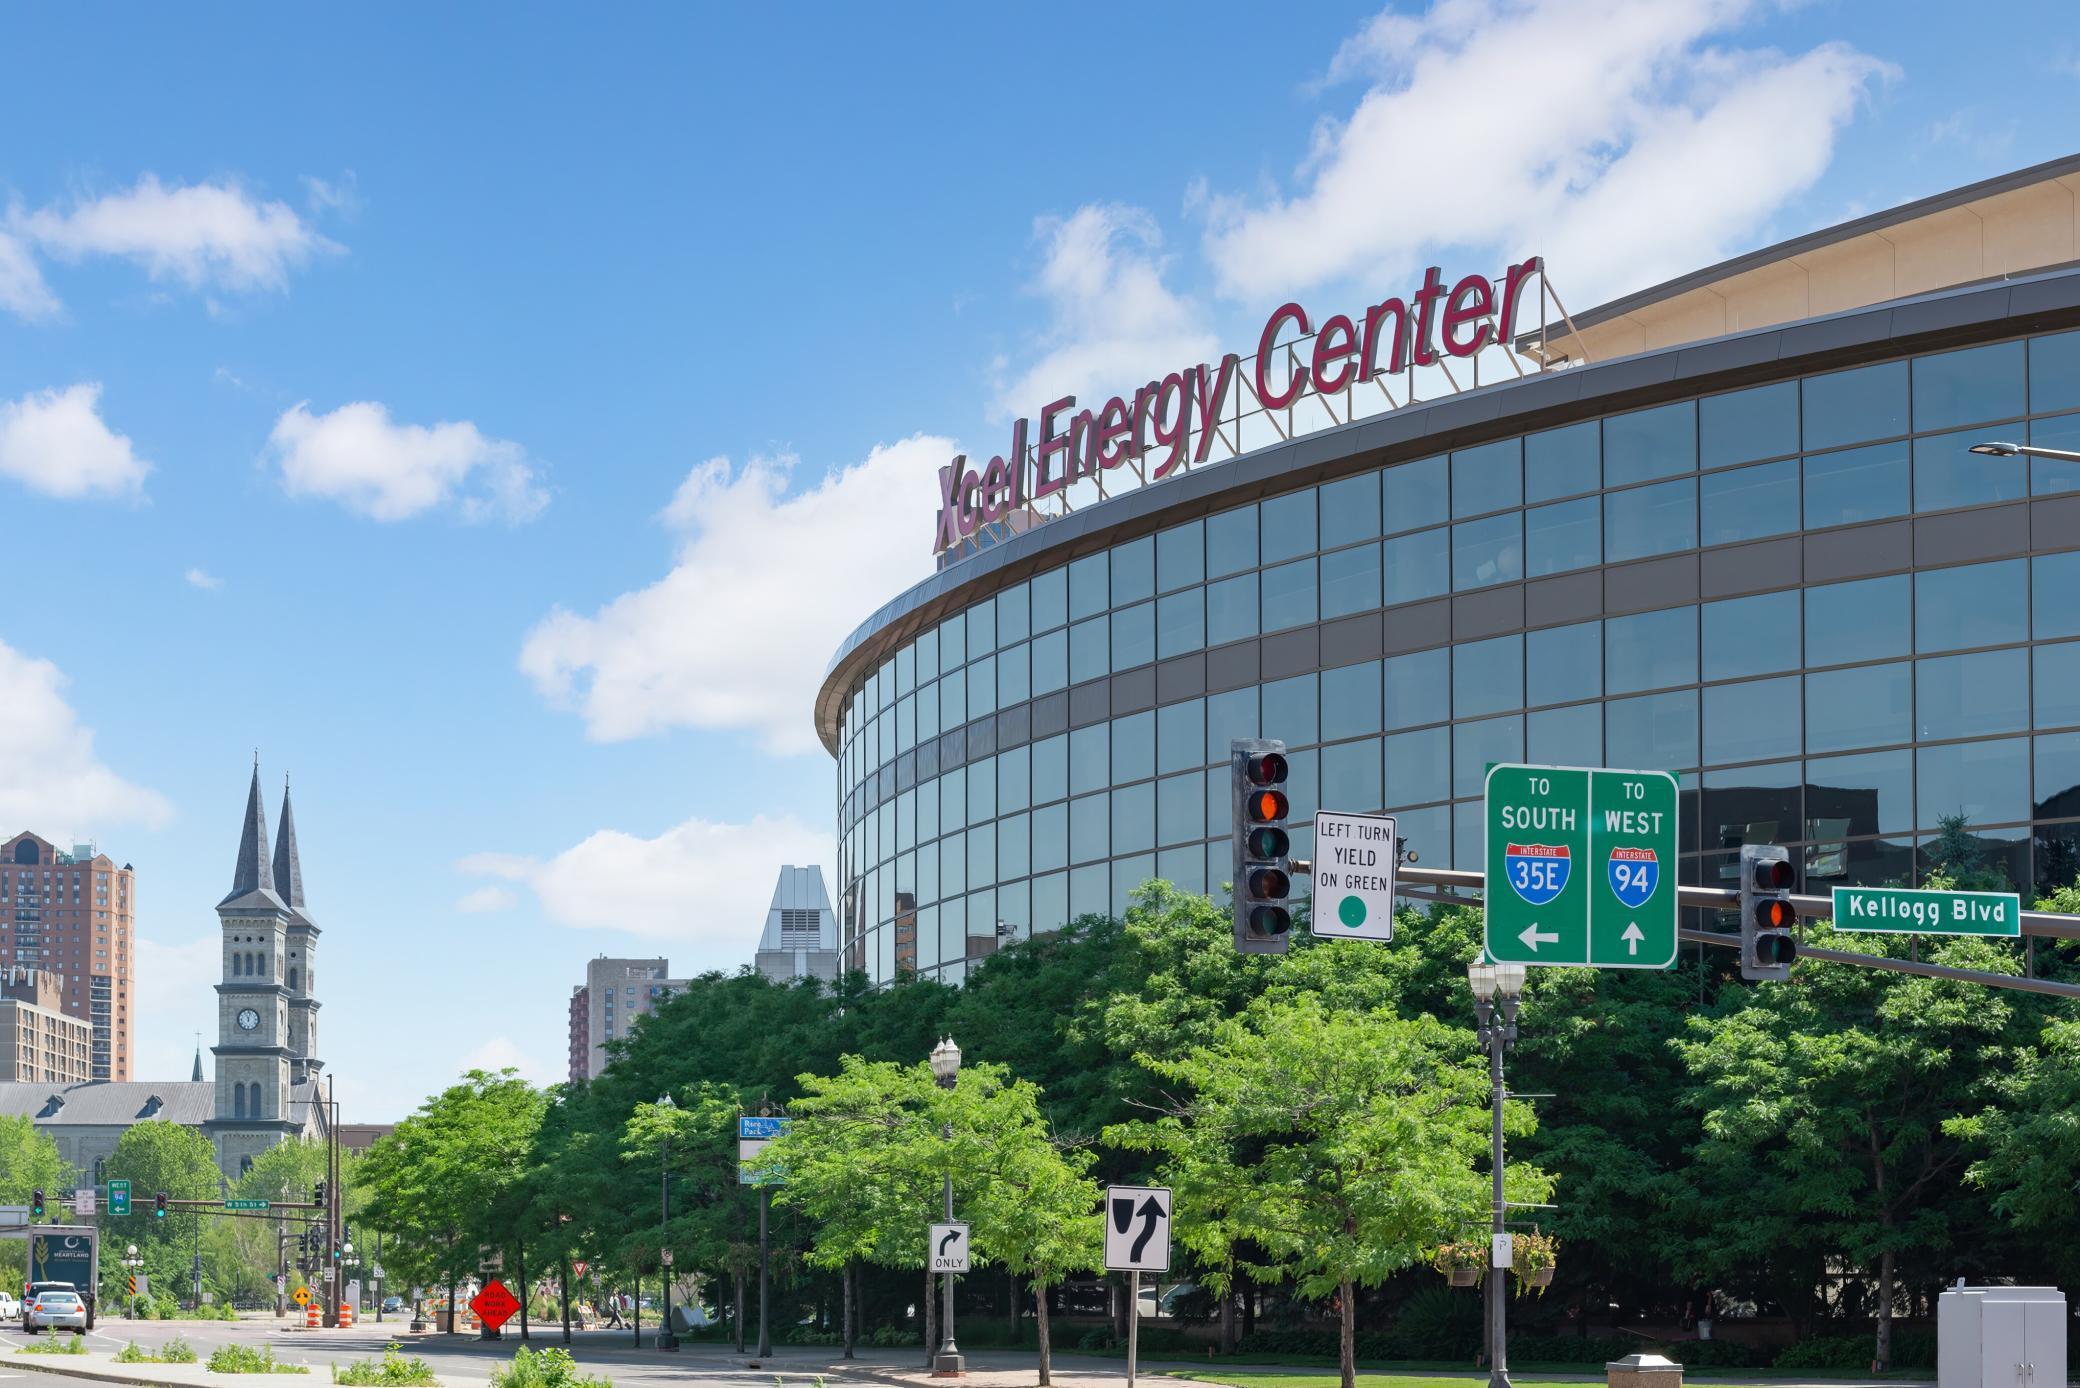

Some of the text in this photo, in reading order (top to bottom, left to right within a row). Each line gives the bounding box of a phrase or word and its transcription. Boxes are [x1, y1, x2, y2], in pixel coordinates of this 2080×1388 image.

[933, 256, 1544, 555] Xcel Energy Center
[1529, 777, 1550, 796] TO
[1622, 782, 1645, 800] TO
[1501, 805, 1576, 831] SOUTH
[1605, 810, 1663, 835] WEST
[1321, 822, 1390, 841] LEFT TURN
[1335, 846, 1377, 867] YIELD
[1520, 847, 1557, 857] INTERSTATE
[1616, 851, 1652, 860] INTERSTATE
[1321, 872, 1388, 892] ON GREEN
[1515, 861, 1559, 890] 35E
[1615, 864, 1649, 893] 94
[1850, 895, 2005, 926] Kellogg Blvd
[744, 1127, 762, 1135] Park
[935, 1258, 964, 1268] ONLY
